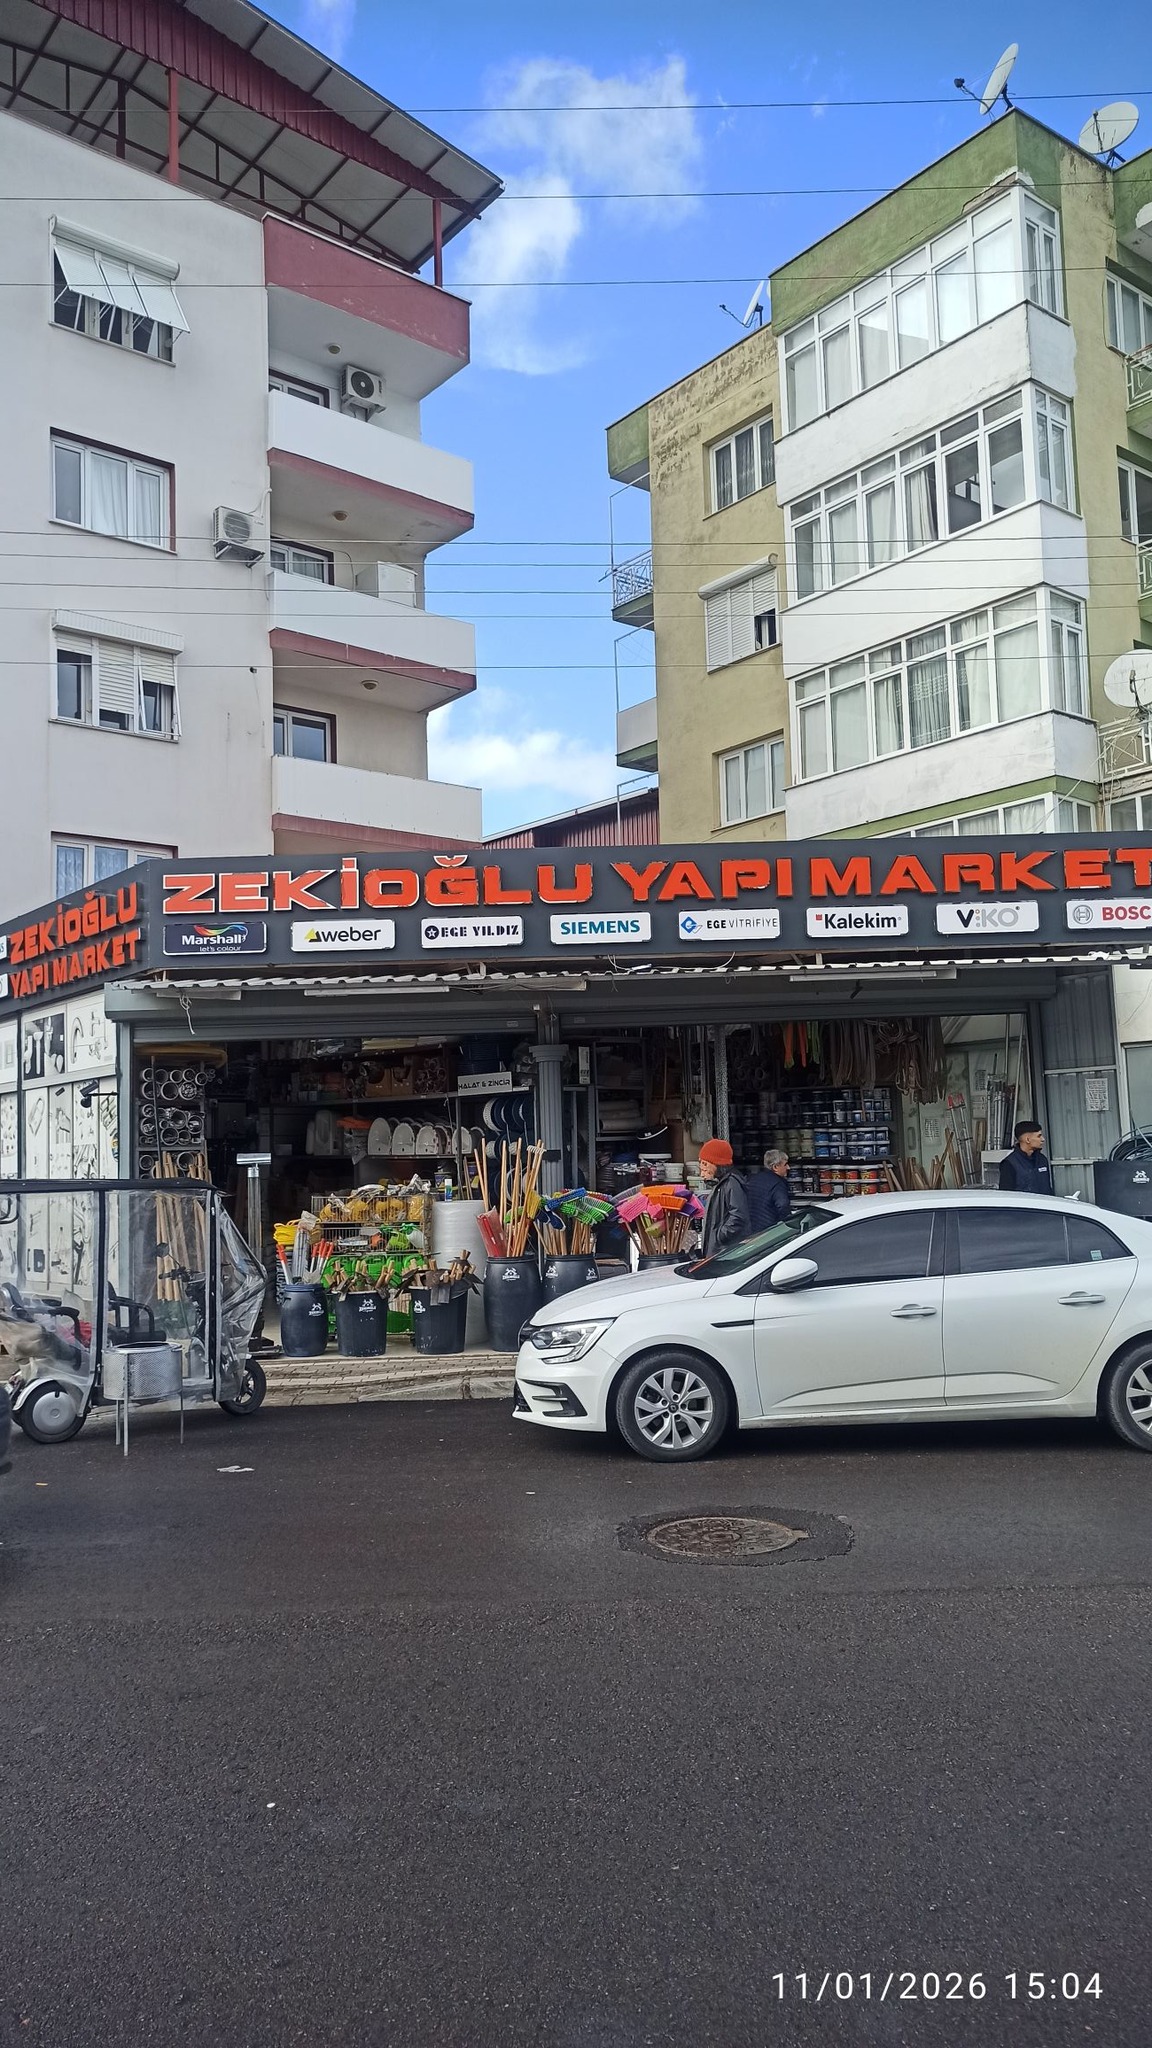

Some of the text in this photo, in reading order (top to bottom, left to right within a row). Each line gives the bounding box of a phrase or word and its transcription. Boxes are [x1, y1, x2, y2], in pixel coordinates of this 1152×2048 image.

[163, 848, 1152, 914] ZEKİOĞLU YAPI MARKET
[1102, 905, 1152, 920] BOSC
[10, 881, 137, 965] ZEKİOĞLU
[560, 920, 641, 935] SIEMENS
[707, 920, 727, 929] EGE
[825, 913, 897, 929] Kalekim
[321, 927, 381, 943] weber
[441, 924, 519, 937] EGE YILDIZ
[182, 934, 242, 945] Marshall
[9, 929, 140, 999] YAPI MARKET
[458, 1082, 480, 1090] HALAT
